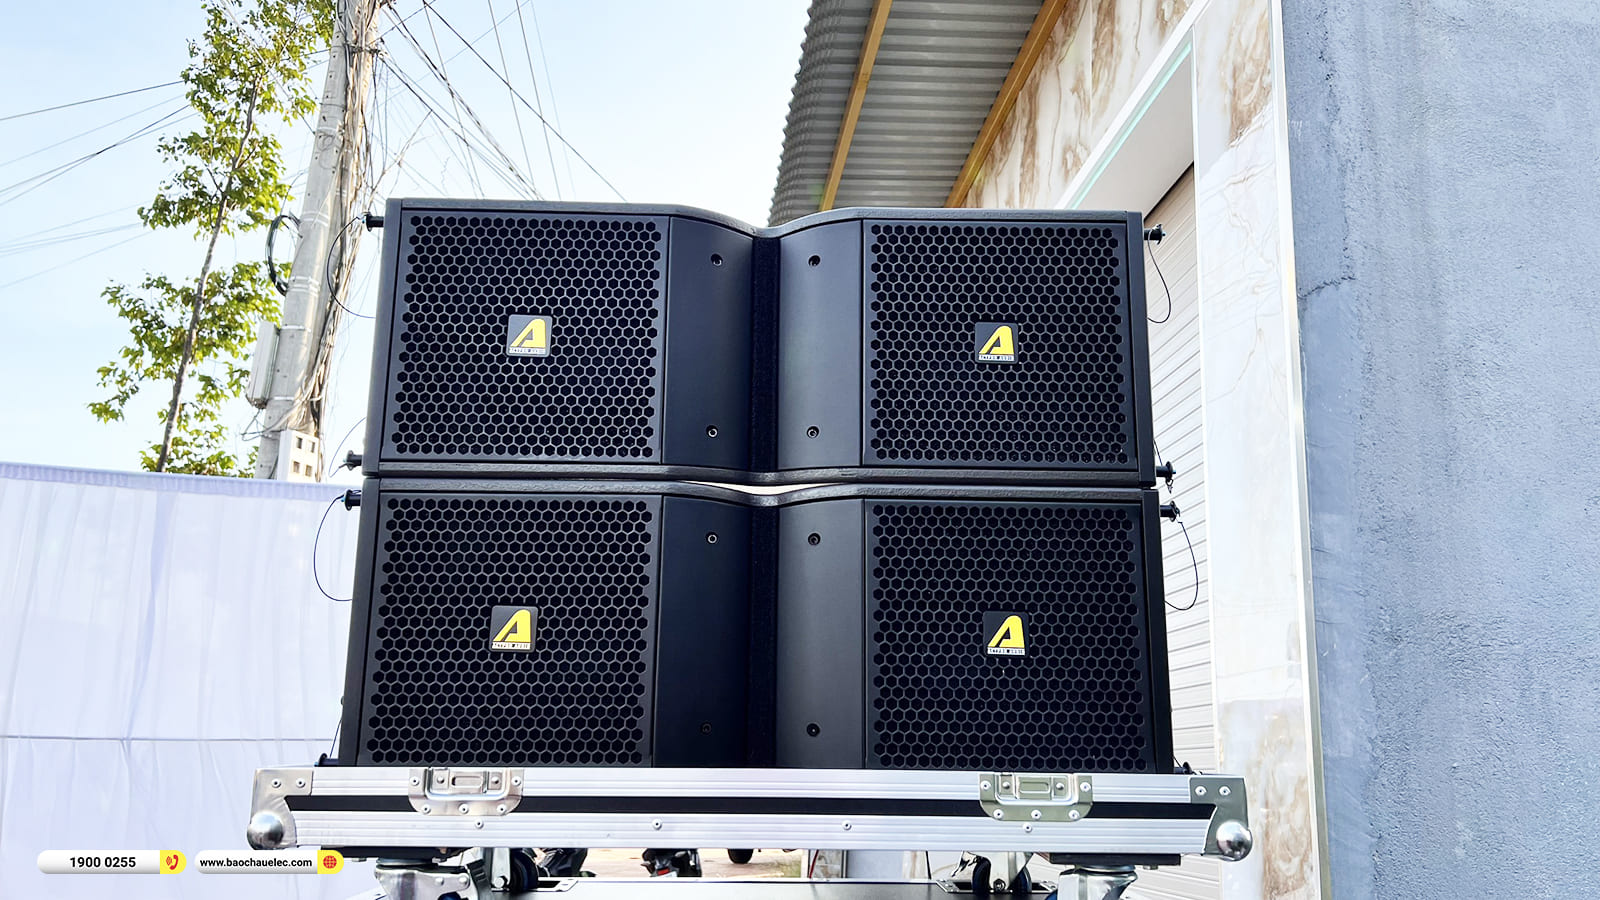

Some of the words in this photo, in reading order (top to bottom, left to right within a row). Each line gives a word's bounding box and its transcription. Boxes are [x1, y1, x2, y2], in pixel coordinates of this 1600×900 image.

[510, 318, 546, 348] A
[978, 325, 1015, 355] A
[492, 609, 532, 642] A
[987, 615, 1025, 648] A
